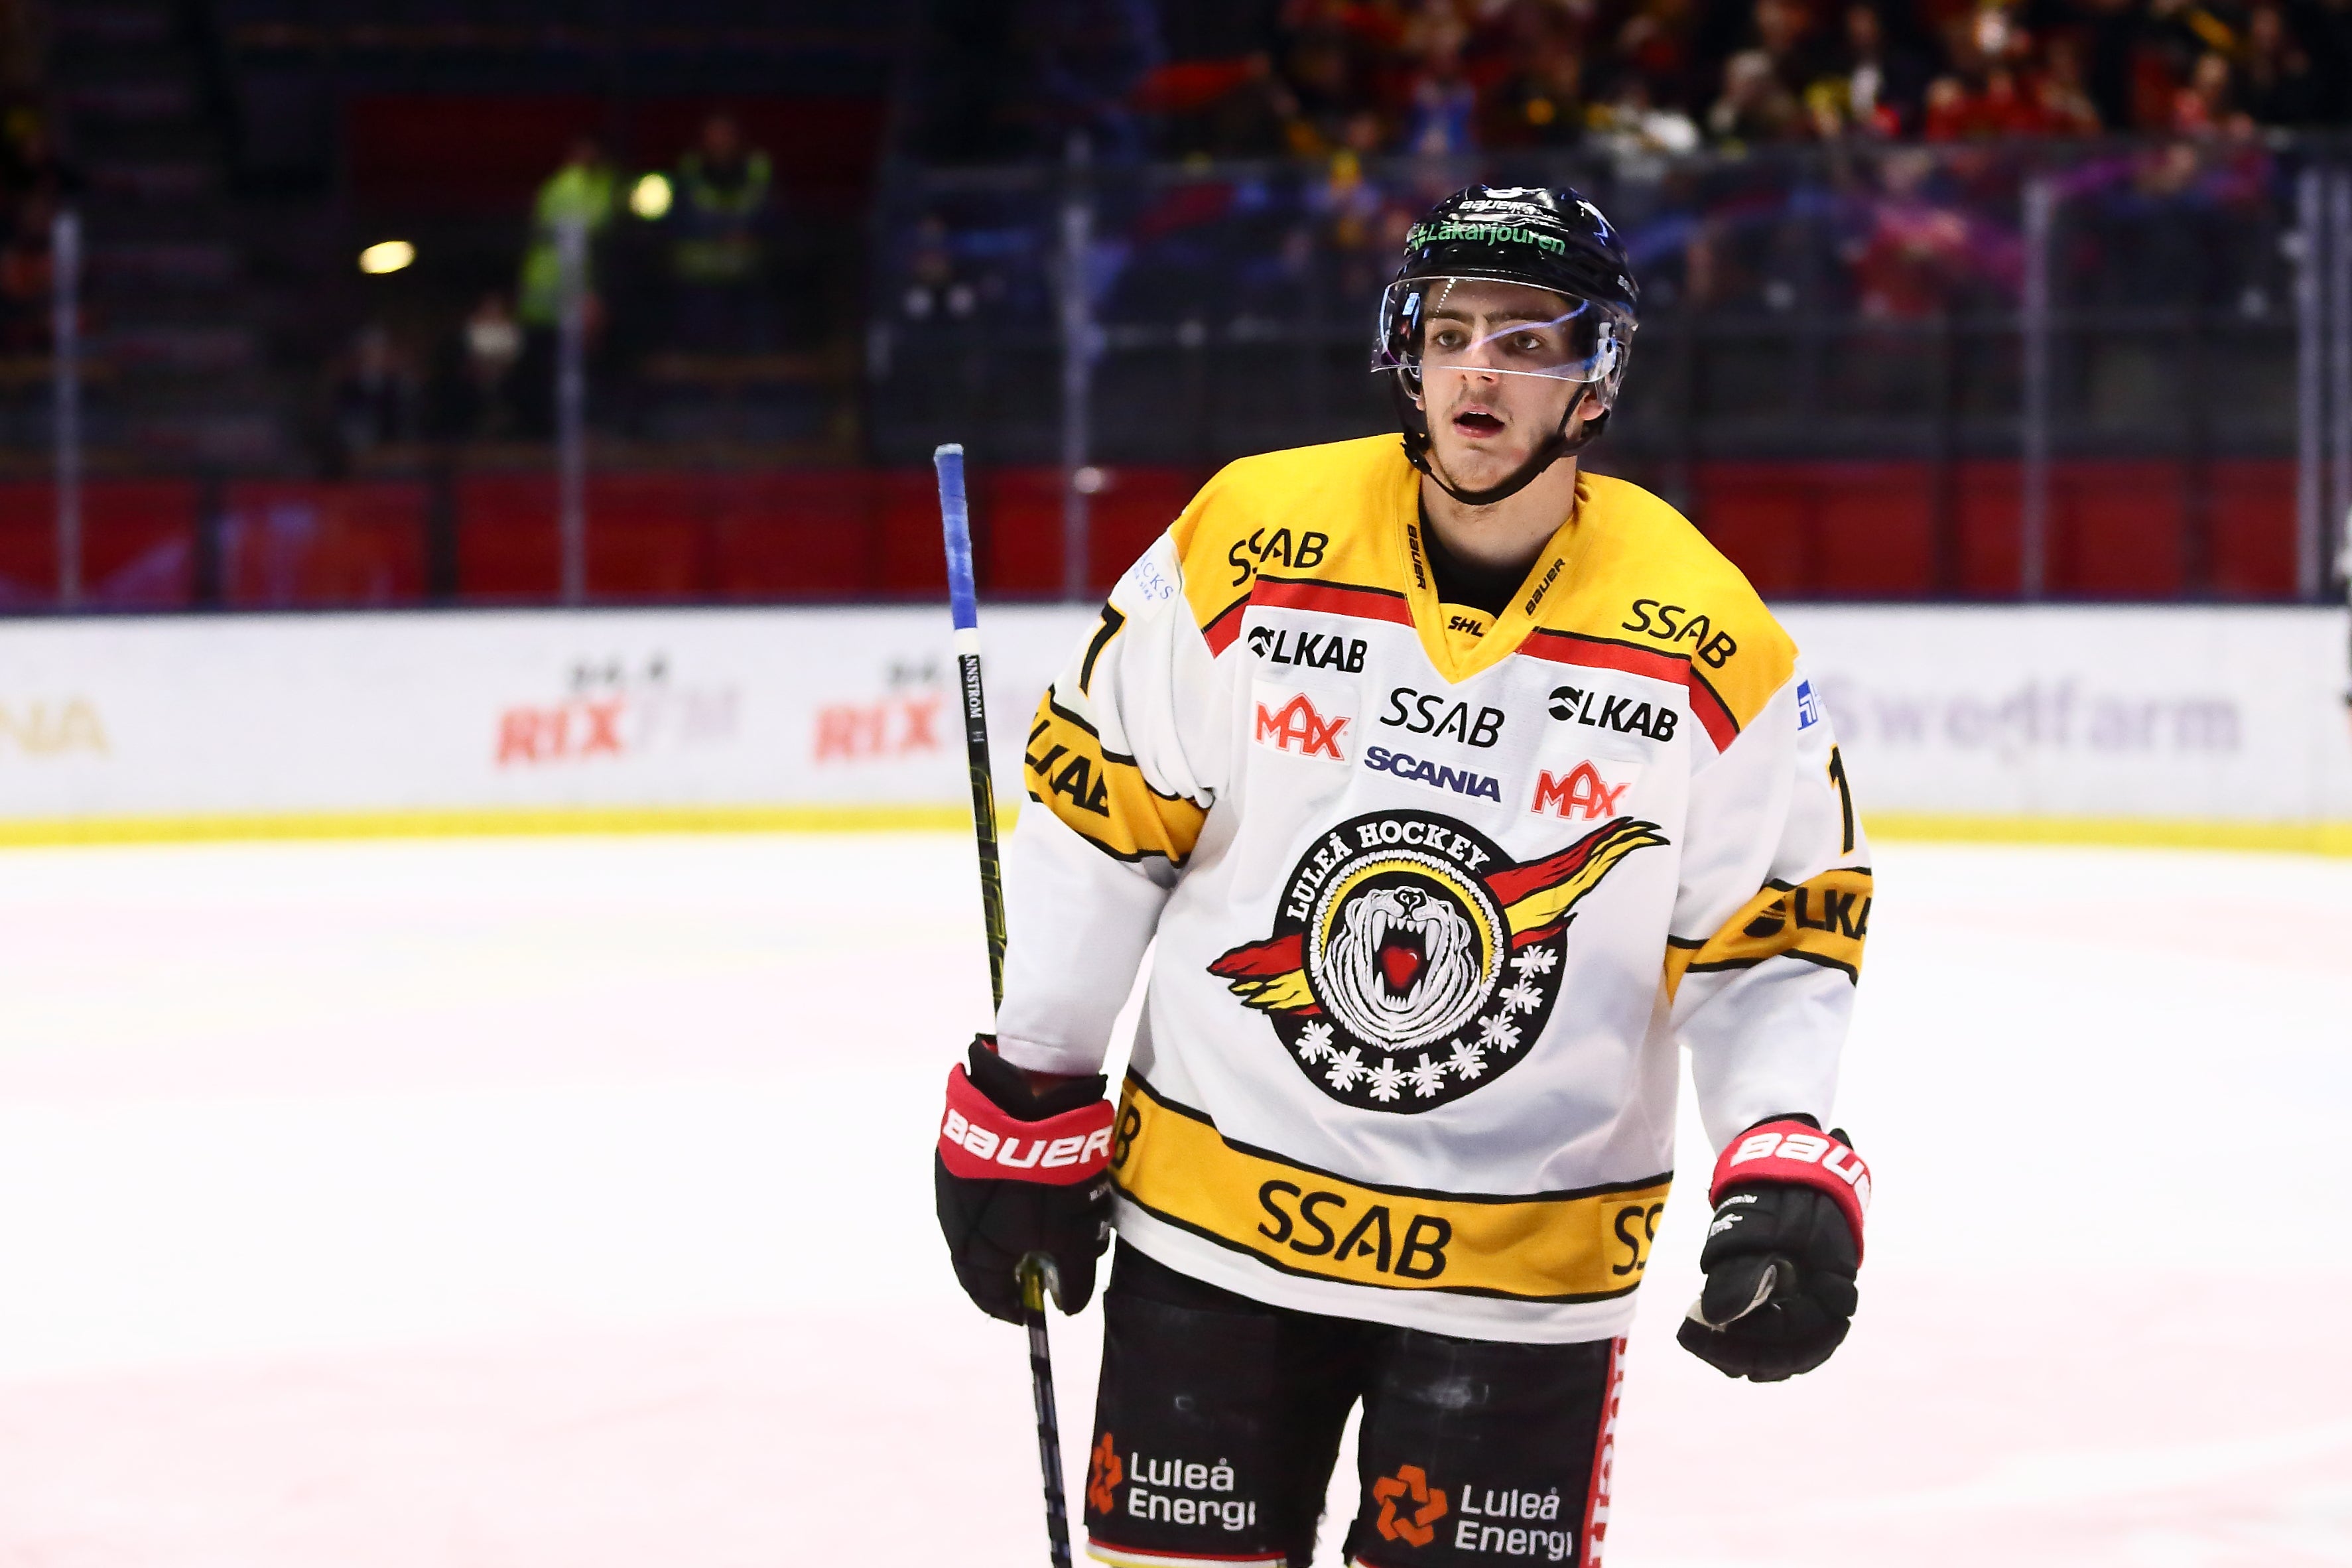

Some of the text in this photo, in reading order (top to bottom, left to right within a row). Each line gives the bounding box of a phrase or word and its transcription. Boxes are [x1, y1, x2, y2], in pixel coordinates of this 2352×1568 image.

[1228, 527, 1329, 586] SSAB
[1271, 629, 1368, 673] LKAB
[1447, 615, 1484, 637] SHL
[1622, 598, 1737, 669] SSAB
[1254, 692, 1352, 761] MAX
[1380, 687, 1505, 748] SSAB
[1579, 691, 1679, 742] LKAB
[1364, 746, 1502, 803] SCANIA
[1531, 759, 1632, 822] MAX
[1286, 820, 1491, 923] LULEÅ HOCKEY
[1258, 1179, 1453, 1279] SSAB
[1130, 1451, 1235, 1492] Luleå
[1128, 1487, 1256, 1532] Energi
[1461, 1484, 1561, 1521] Luleå
[1455, 1519, 1573, 1561] Energi
